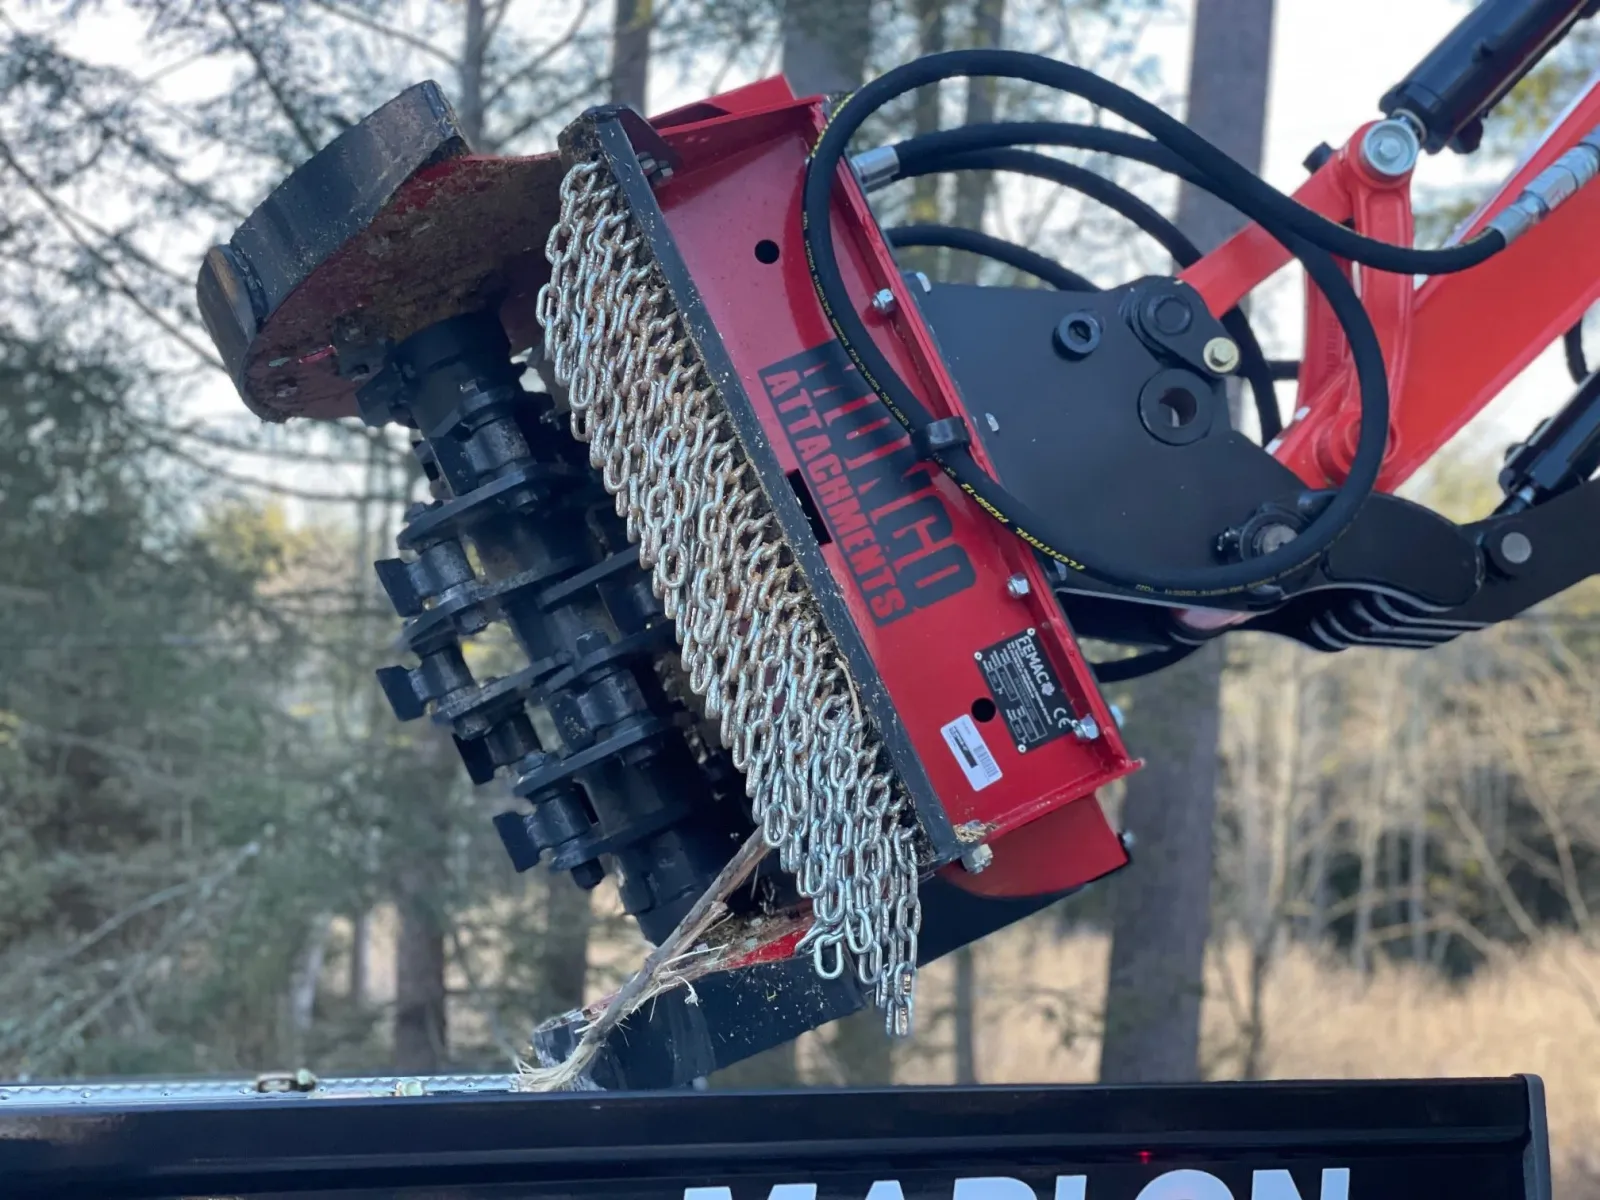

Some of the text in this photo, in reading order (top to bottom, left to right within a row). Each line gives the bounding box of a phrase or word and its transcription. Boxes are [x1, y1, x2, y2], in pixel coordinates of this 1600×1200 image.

[763, 368, 907, 621] ATTACHMENTS
[793, 335, 976, 610] MONGO
[1016, 634, 1050, 684] FEMAC
